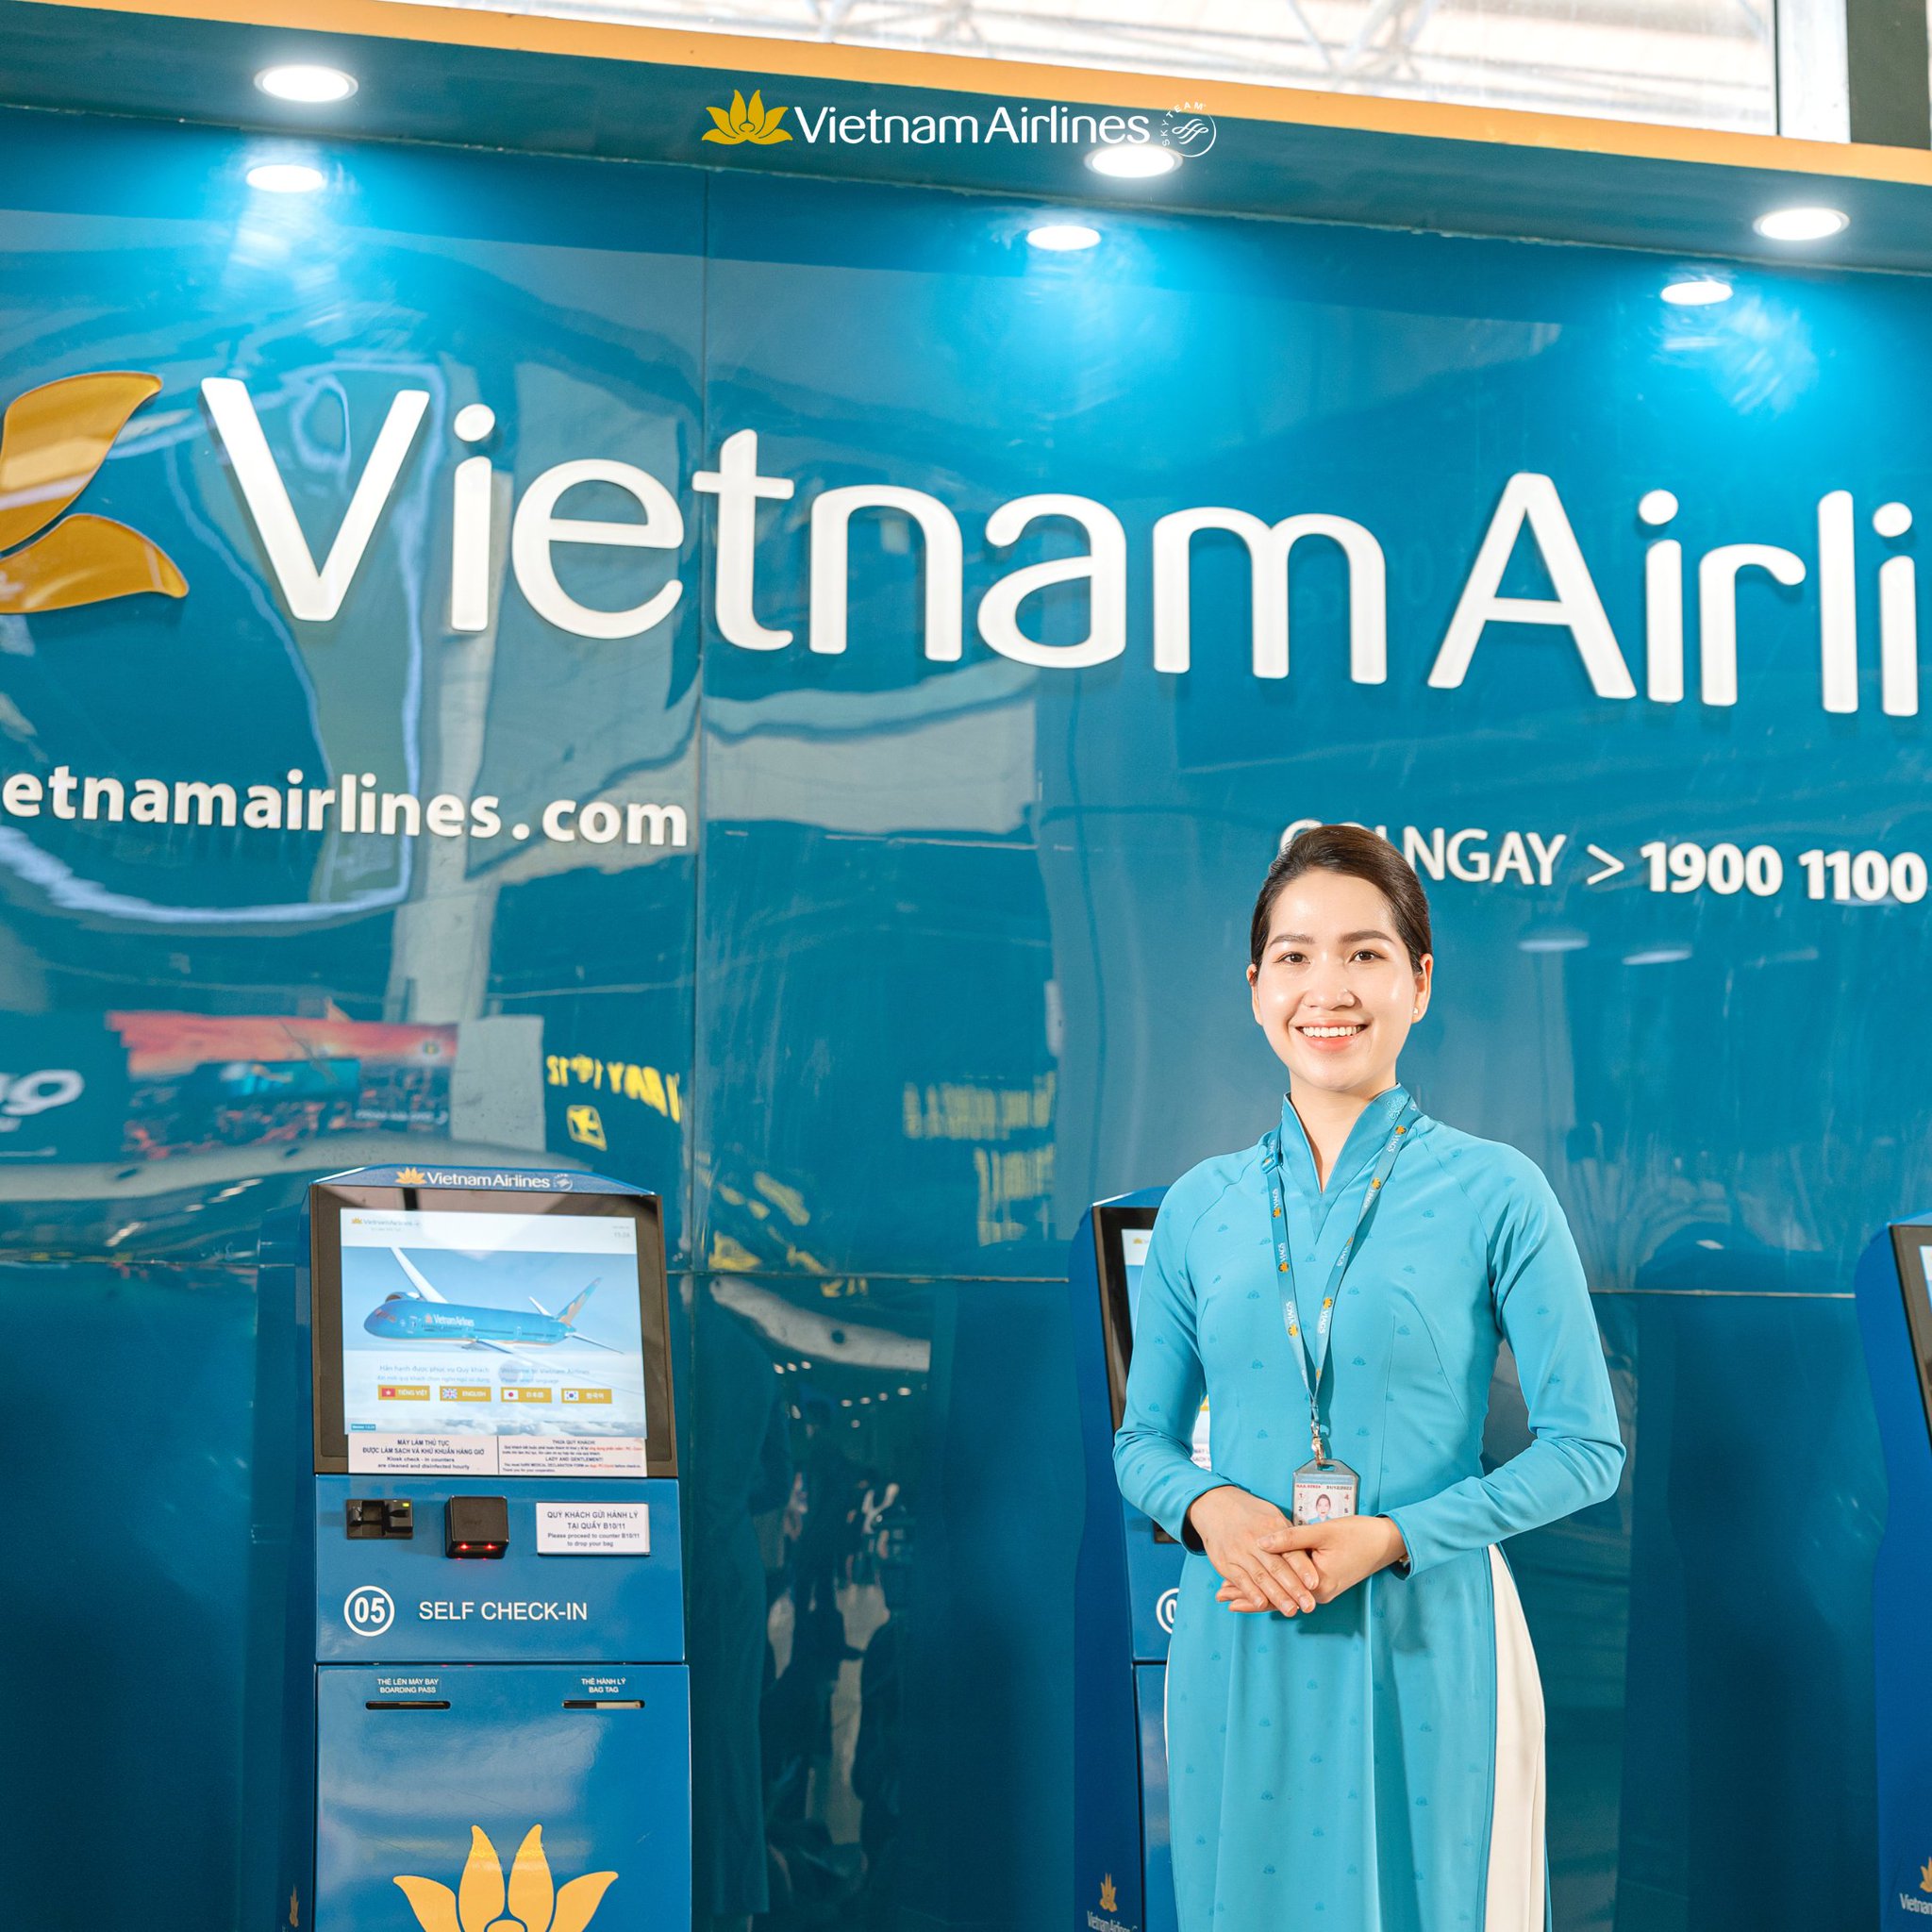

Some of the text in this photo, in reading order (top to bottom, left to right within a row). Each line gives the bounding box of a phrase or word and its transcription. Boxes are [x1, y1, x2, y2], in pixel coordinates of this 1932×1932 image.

[200, 376, 1919, 717] Vietnam Airli
[1403, 824, 1567, 886] NGAY
[1640, 841, 1784, 896] 1900
[1798, 848, 1929, 904] 1100
[427, 1172, 491, 1186] Vietnam
[492, 1174, 551, 1189] Airlines
[1286, 1300, 1295, 1325] VIAGS
[1318, 1309, 1329, 1335] VIAGS
[547, 1510, 562, 1519] QUÝ
[564, 1510, 591, 1519] KHÁCH
[607, 1510, 627, 1519] HÀNH
[354, 1596, 386, 1624] 05
[419, 1601, 588, 1621] SELF CHECK-IN
